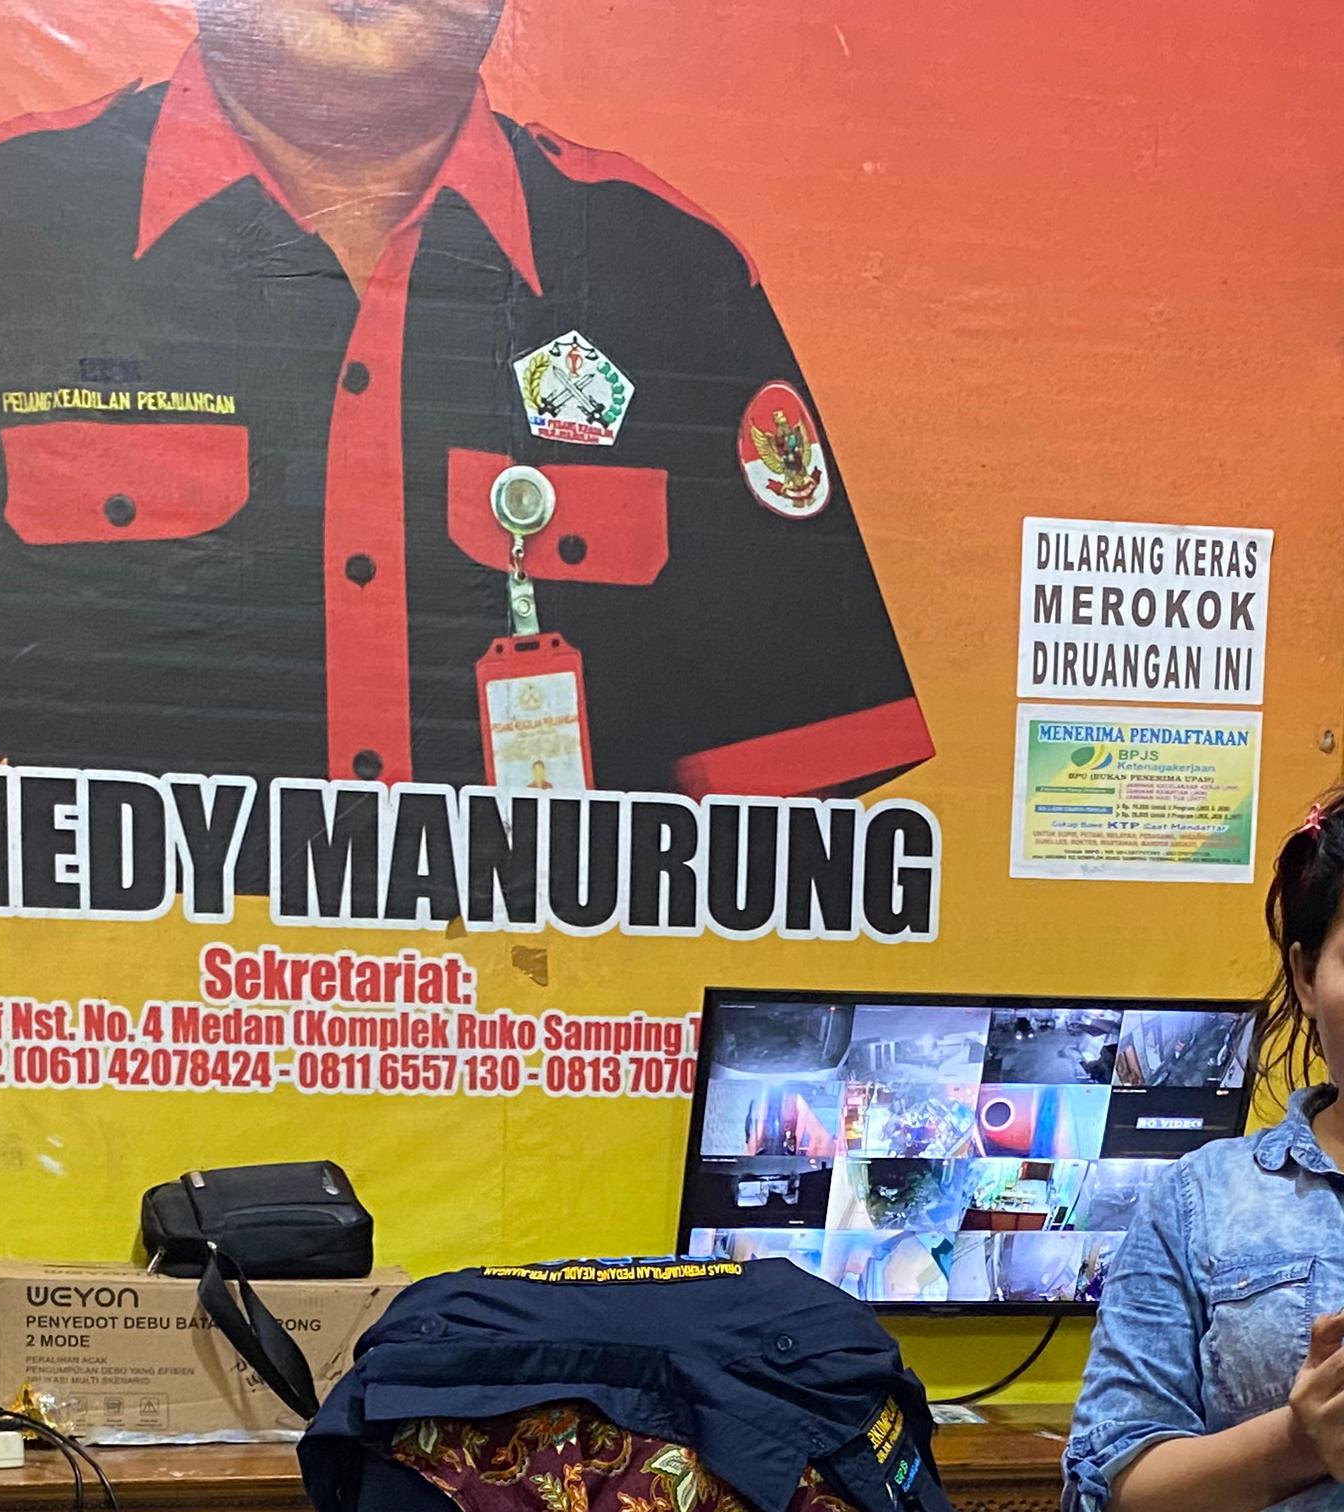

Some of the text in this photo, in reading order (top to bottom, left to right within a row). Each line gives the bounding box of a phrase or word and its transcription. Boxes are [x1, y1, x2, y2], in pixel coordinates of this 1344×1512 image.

[1036, 531, 1258, 579] DILARANG KERAS
[1033, 583, 1257, 632] MEROKOK
[1032, 640, 1254, 692] DIRUANGAN INI
[1039, 725, 1249, 746] MENERIMA PENDAFTARAN
[1118, 749, 1159, 761] BPJS
[1106, 821, 1141, 830] KTP
[279, 787, 935, 936] MANURUNG
[204, 946, 473, 1005] Sekretariat:
[12, 1003, 77, 1042] Nst.
[83, 1004, 135, 1043] No.
[141, 1005, 164, 1044] 4
[171, 1006, 284, 1047] Medan
[293, 1011, 450, 1058] (Komplek
[457, 1013, 537, 1051] Ruko
[543, 1015, 684, 1063] Samping
[13, 1044, 101, 1085] (061)
[107, 1047, 272, 1087] 42078424
[297, 1052, 373, 1090] 0811
[379, 1054, 457, 1091] 6557
[465, 1055, 521, 1092] 130
[545, 1057, 621, 1094] 0813
[629, 1058, 697, 1095] 7070
[1137, 1118, 1203, 1130] NO VIDEO
[596, 1265, 637, 1282] PEDANG
[26, 1285, 140, 1309] WEYON
[25, 1315, 119, 1329] PENYEDOT
[123, 1316, 171, 1330] DEBU
[25, 1334, 91, 1348] 2 MODE
